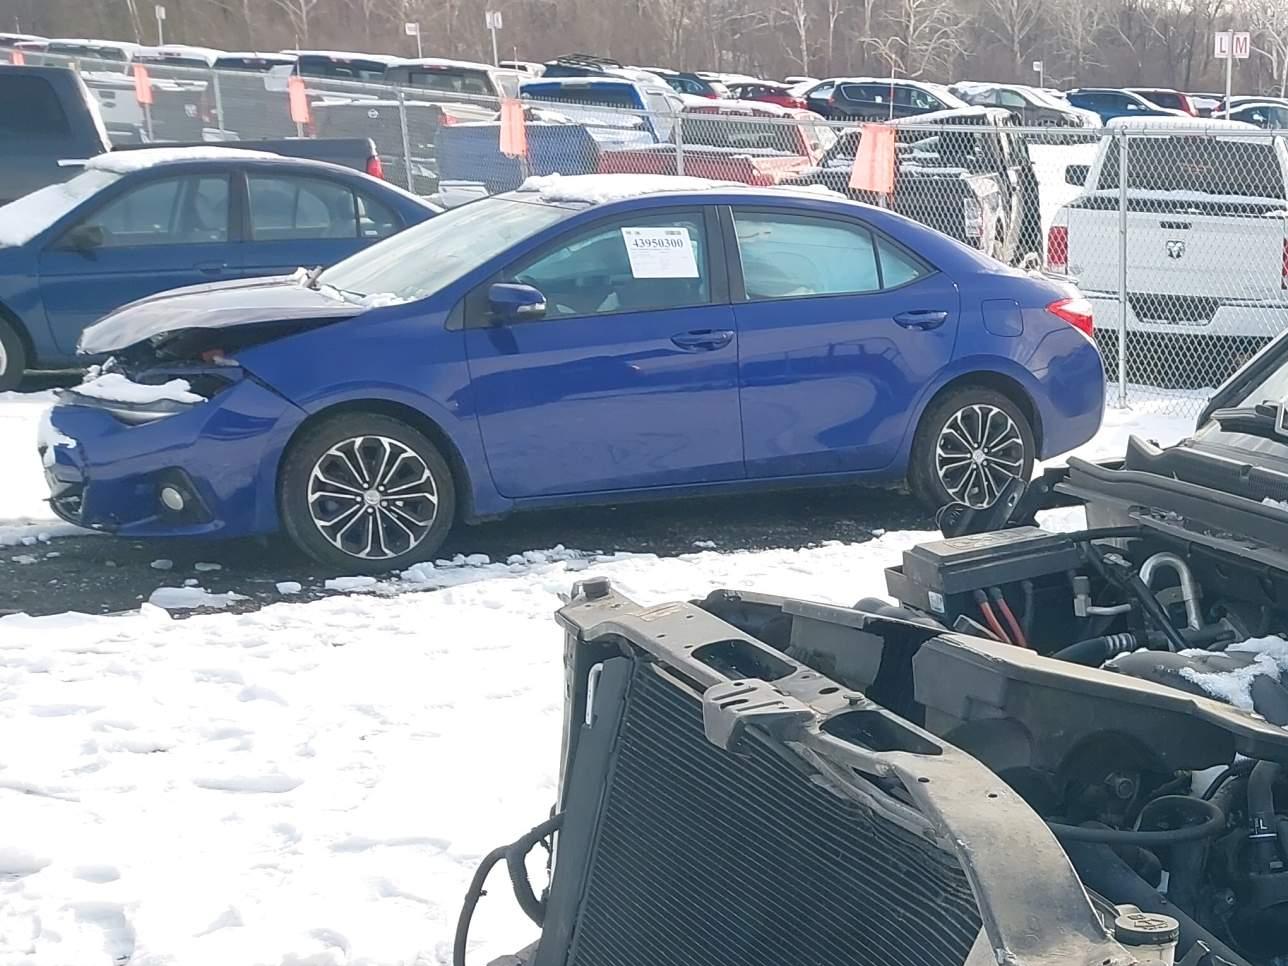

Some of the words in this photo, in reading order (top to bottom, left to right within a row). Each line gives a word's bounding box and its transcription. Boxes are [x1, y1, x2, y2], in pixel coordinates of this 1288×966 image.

[1220, 37, 1227, 53] L
[1236, 37, 1248, 54] M
[632, 238, 684, 248] 43950300
